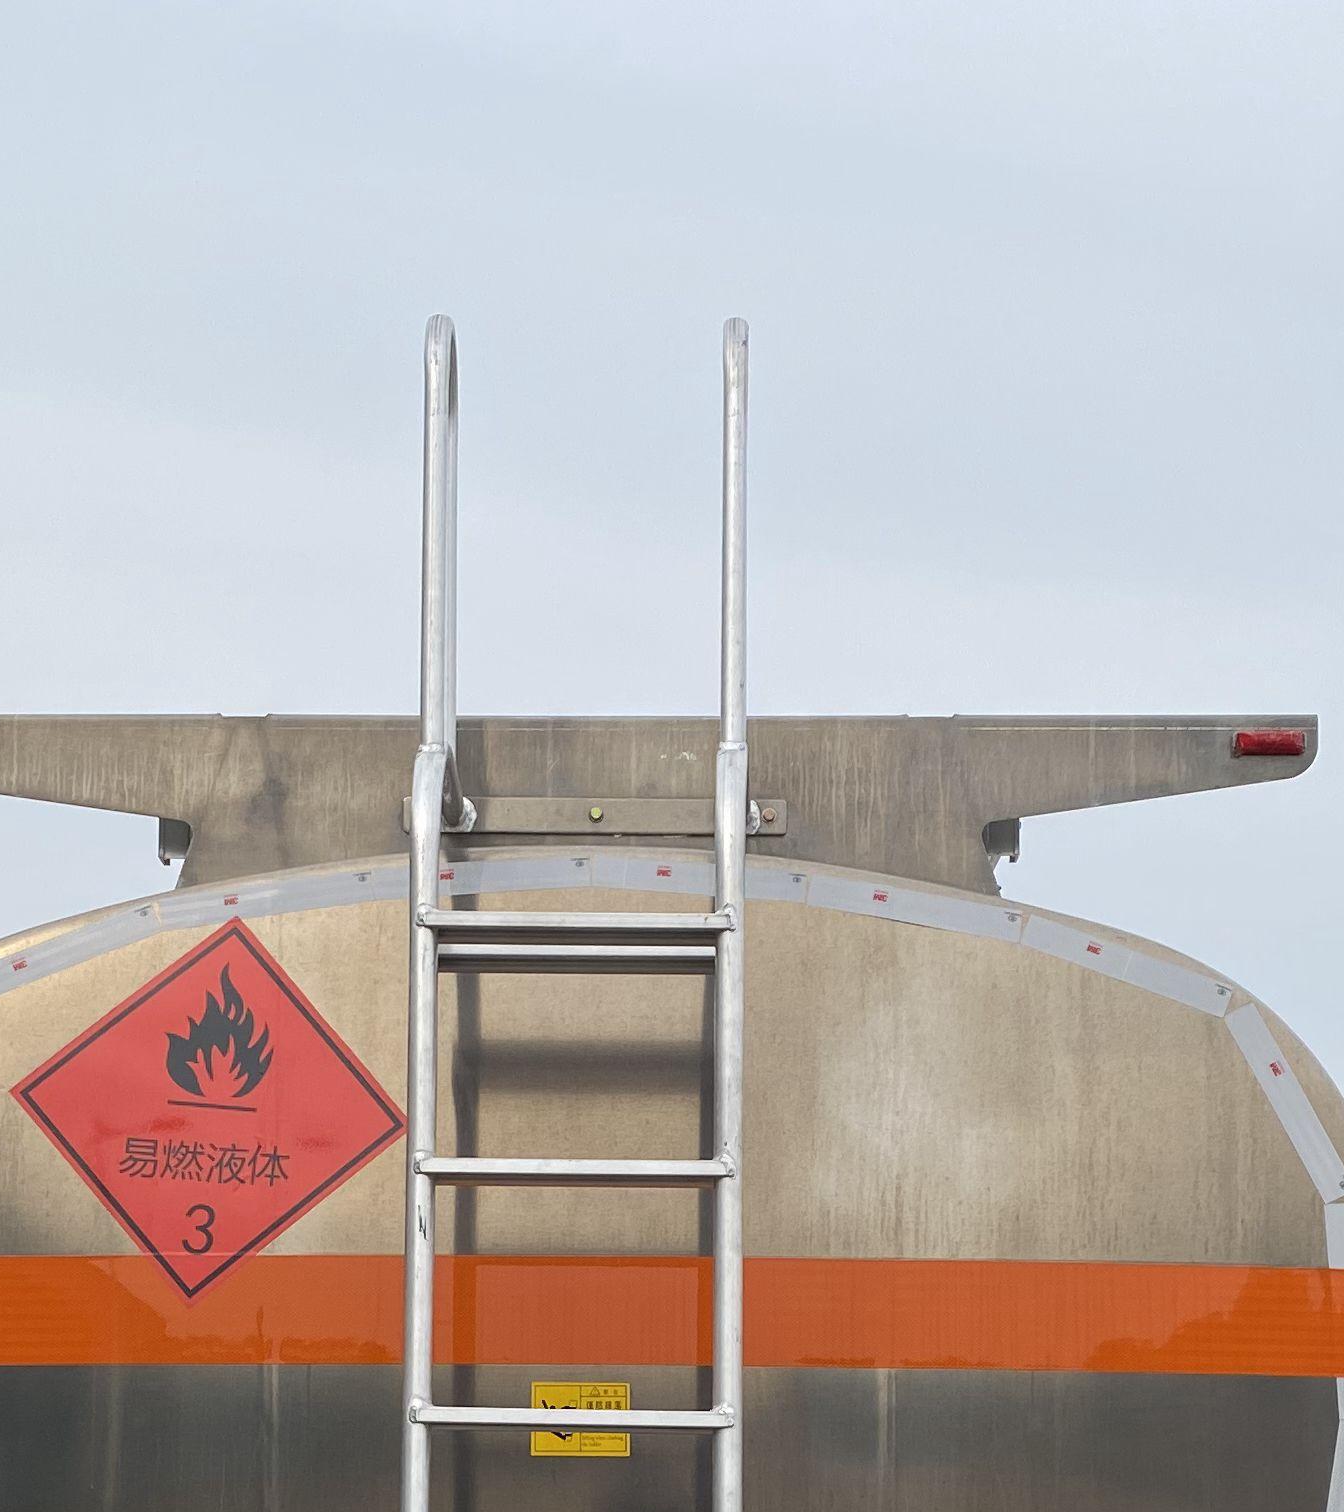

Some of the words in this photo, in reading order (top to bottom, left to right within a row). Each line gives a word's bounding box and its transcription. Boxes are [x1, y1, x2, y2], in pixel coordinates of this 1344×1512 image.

[119, 1137, 289, 1187] 易燃液体
[181, 1203, 216, 1255] 3
